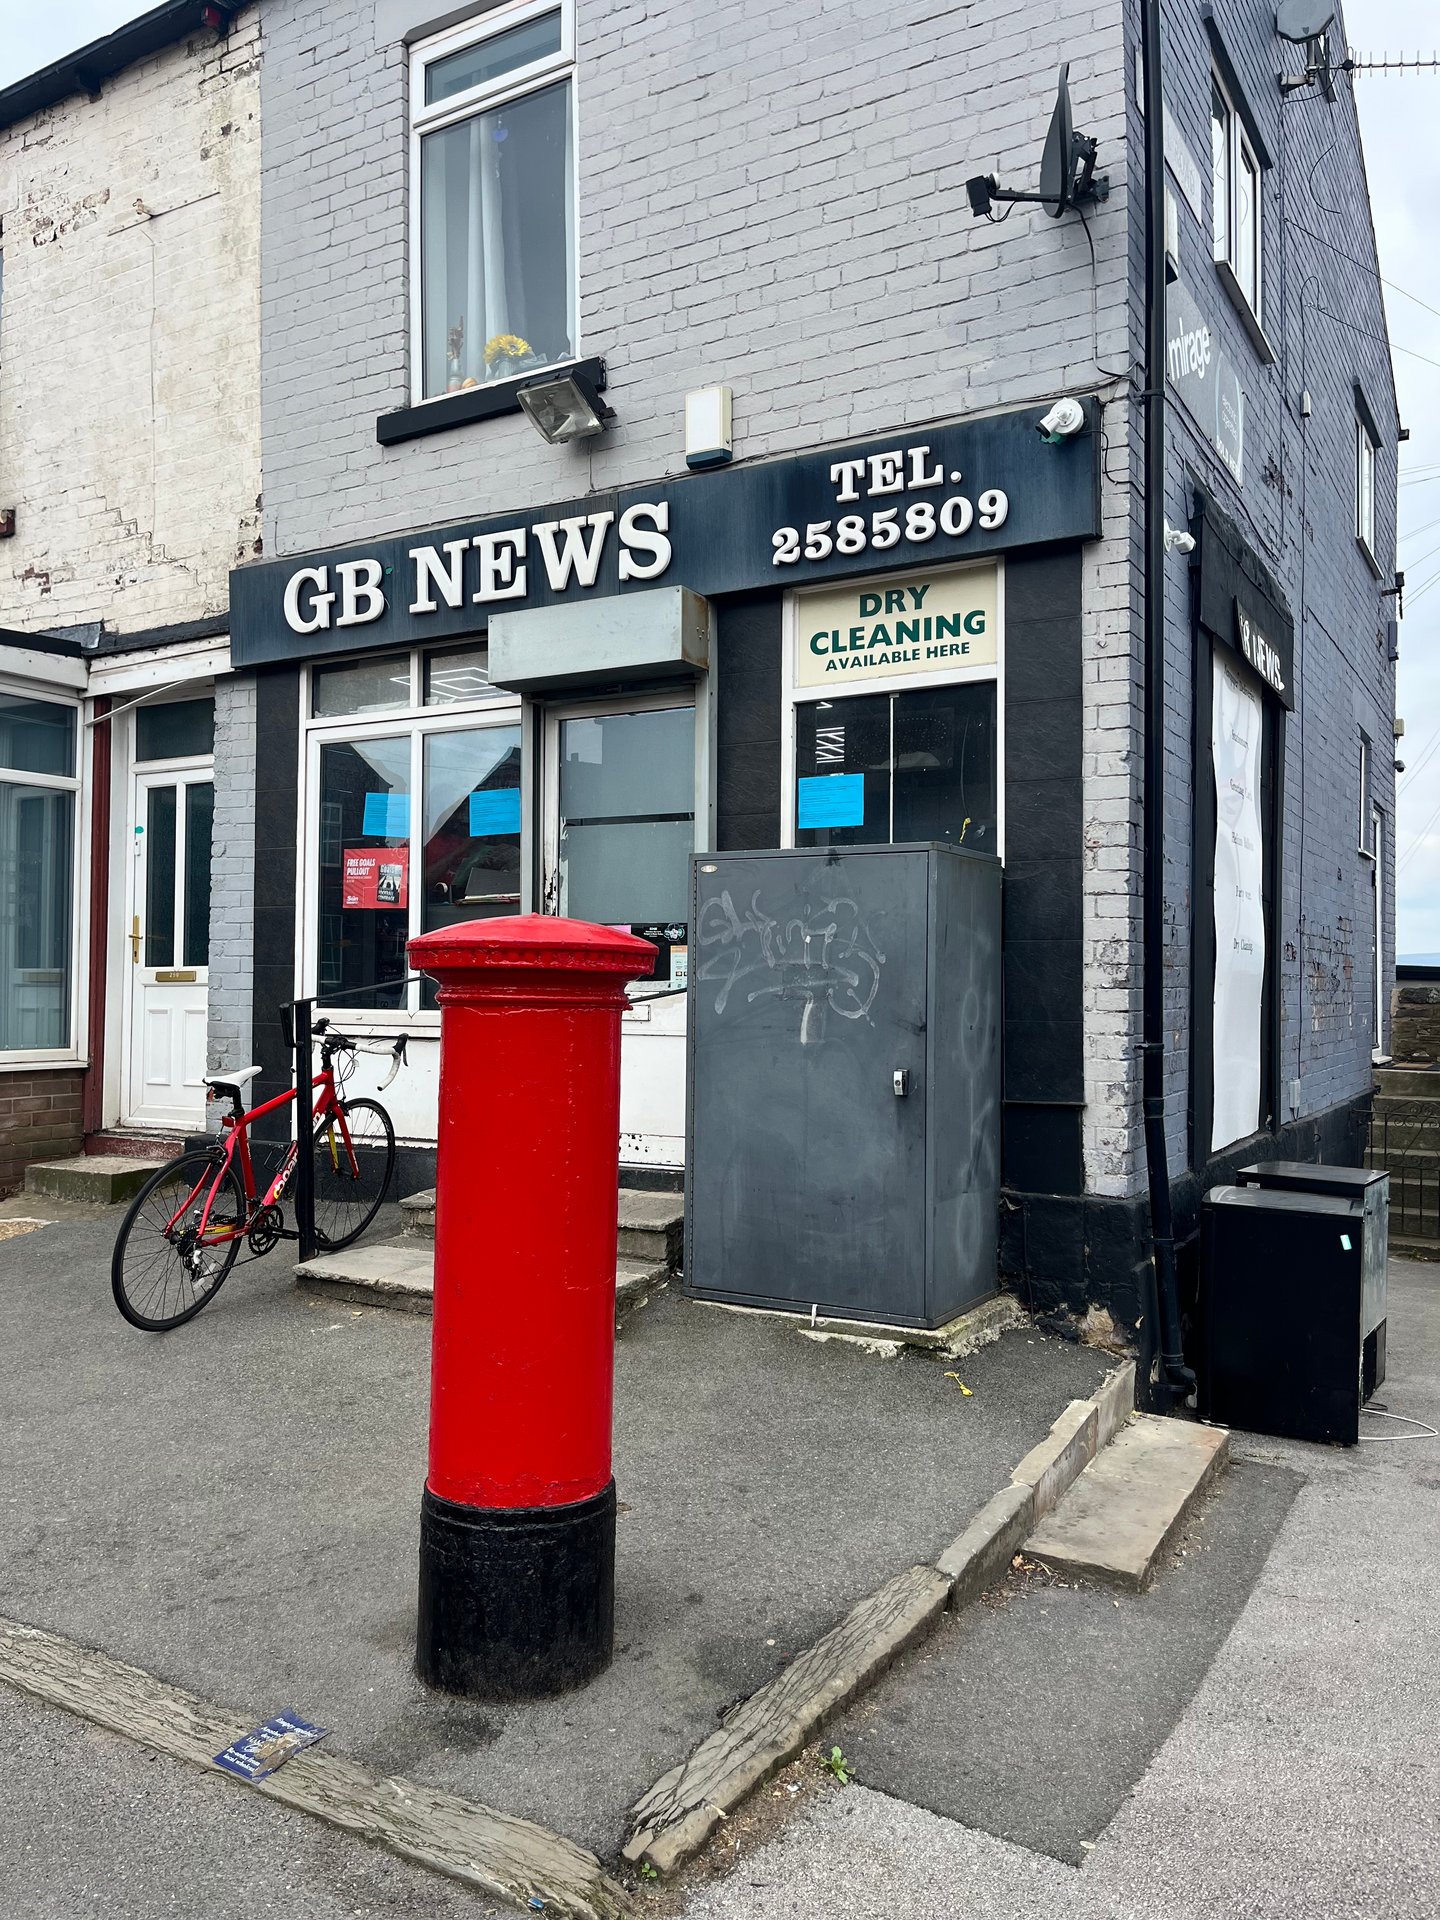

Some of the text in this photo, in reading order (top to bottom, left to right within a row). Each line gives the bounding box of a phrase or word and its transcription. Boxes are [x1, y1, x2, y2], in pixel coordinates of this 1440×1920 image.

[1168, 317, 1211, 381] mirage
[830, 446, 962, 503] TEL.
[772, 489, 1009, 566] 2585809
[283, 501, 672, 633] GB NEWS
[859, 584, 930, 618] DRY
[809, 610, 986, 656] CLEANING
[825, 641, 970, 671] AVAILABLE HERE
[346, 858, 376, 867] FREE GOALS
